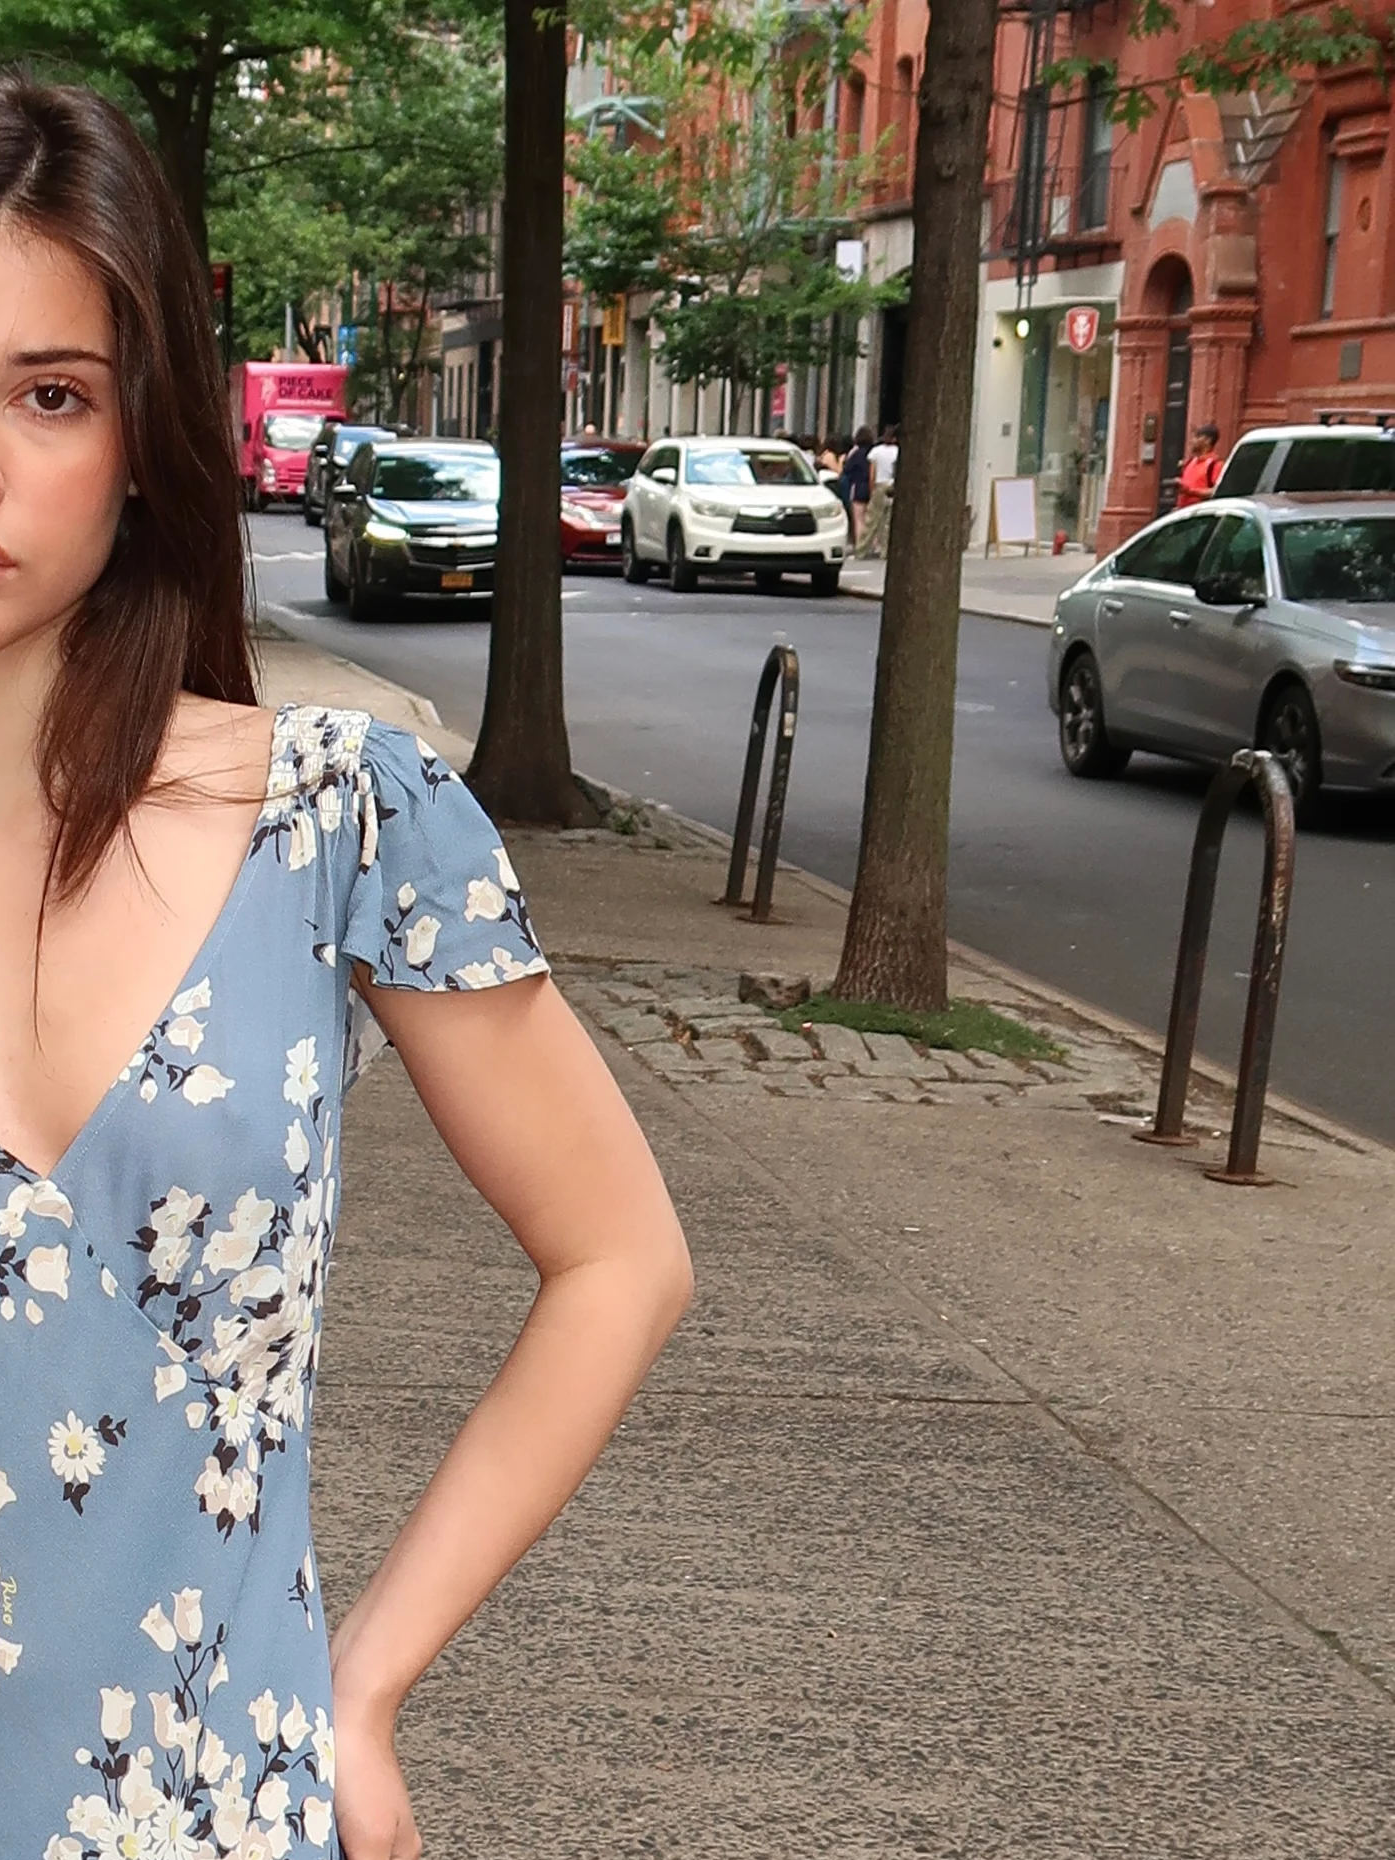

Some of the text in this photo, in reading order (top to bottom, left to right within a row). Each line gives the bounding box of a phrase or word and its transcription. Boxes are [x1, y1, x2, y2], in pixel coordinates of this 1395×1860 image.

[278, 376, 313, 387] PIECE
[278, 387, 334, 399] OF CAKE
